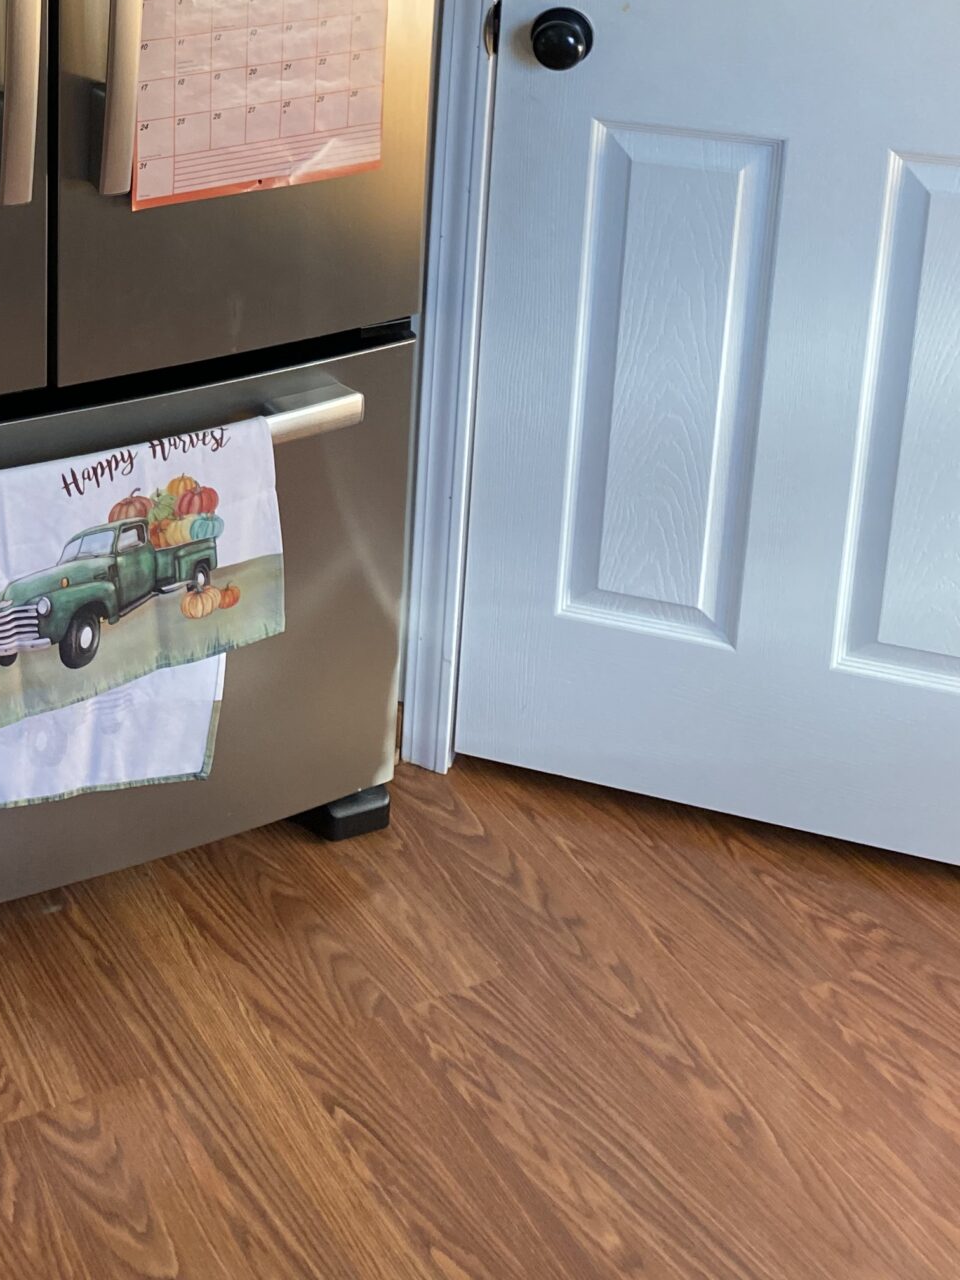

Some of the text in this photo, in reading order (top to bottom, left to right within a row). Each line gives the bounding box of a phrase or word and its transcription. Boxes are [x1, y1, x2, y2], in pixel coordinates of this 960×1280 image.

[249, 68, 258, 76] 20
[140, 123, 150, 132] 24
[61, 426, 231, 497] Happy Harvest
